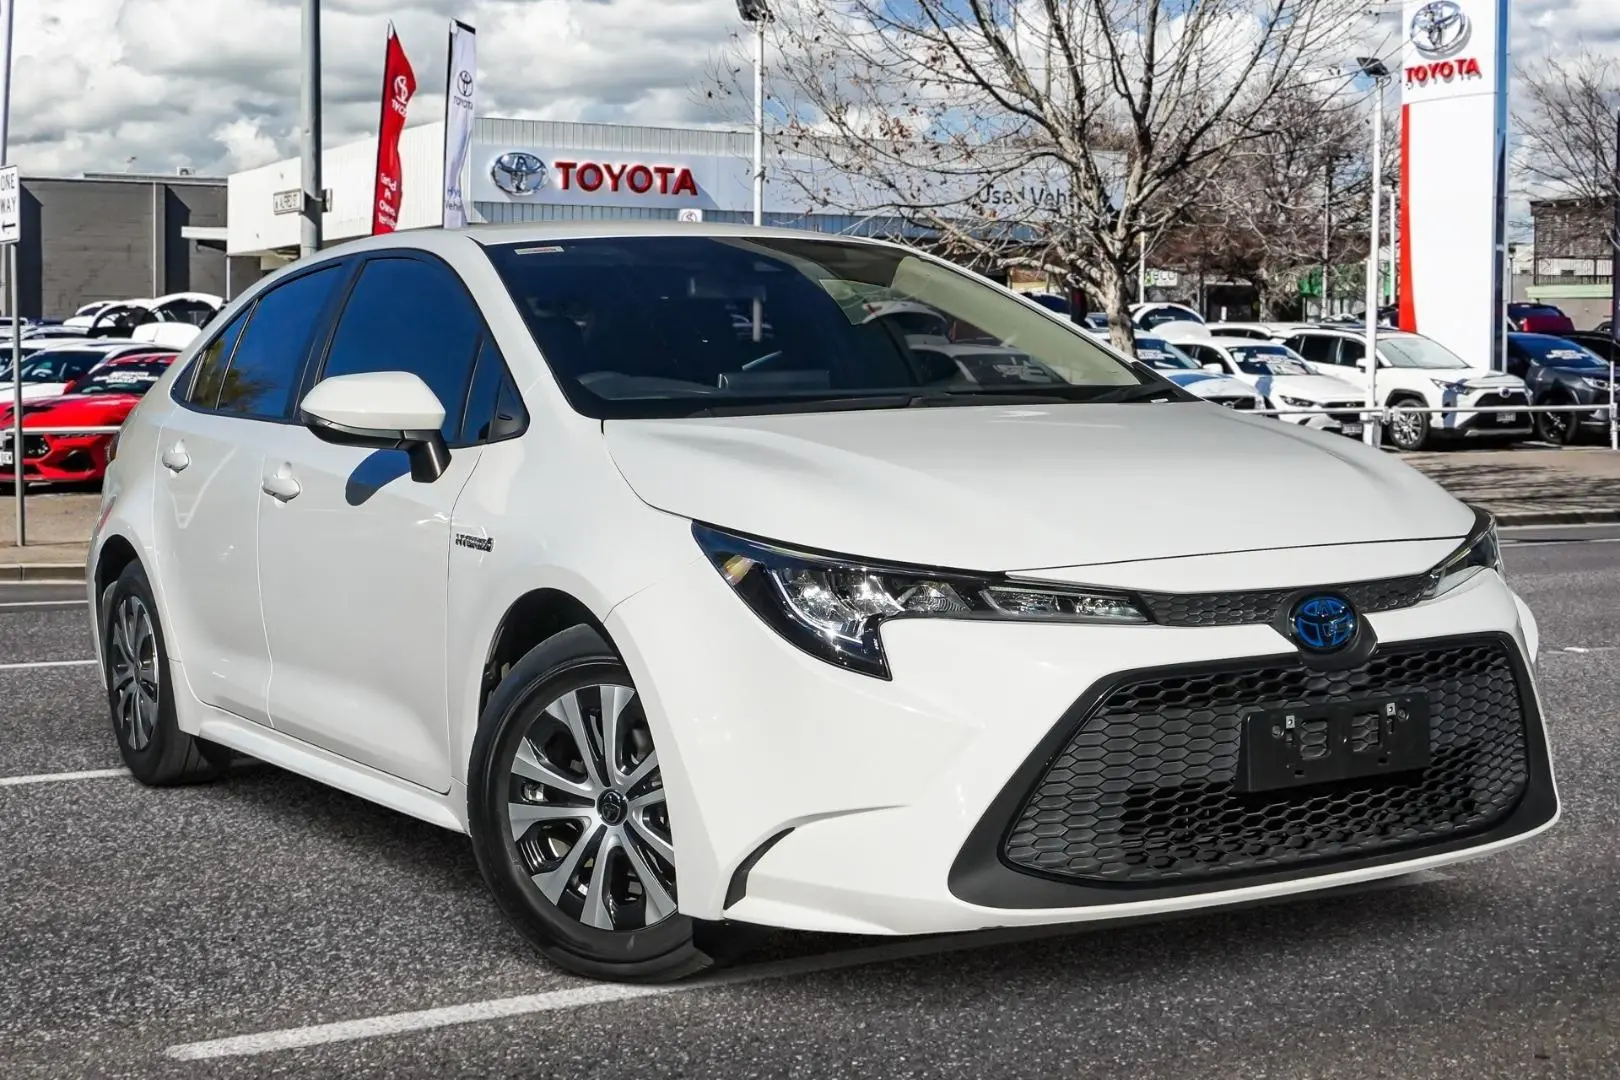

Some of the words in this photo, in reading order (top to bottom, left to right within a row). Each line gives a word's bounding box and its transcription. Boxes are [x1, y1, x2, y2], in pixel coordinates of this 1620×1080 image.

[1404, 57, 1482, 83] TOYOTA
[0, 173, 15, 191] ONE
[554, 161, 698, 196] TOYOTA
[0, 196, 16, 214] WAY
